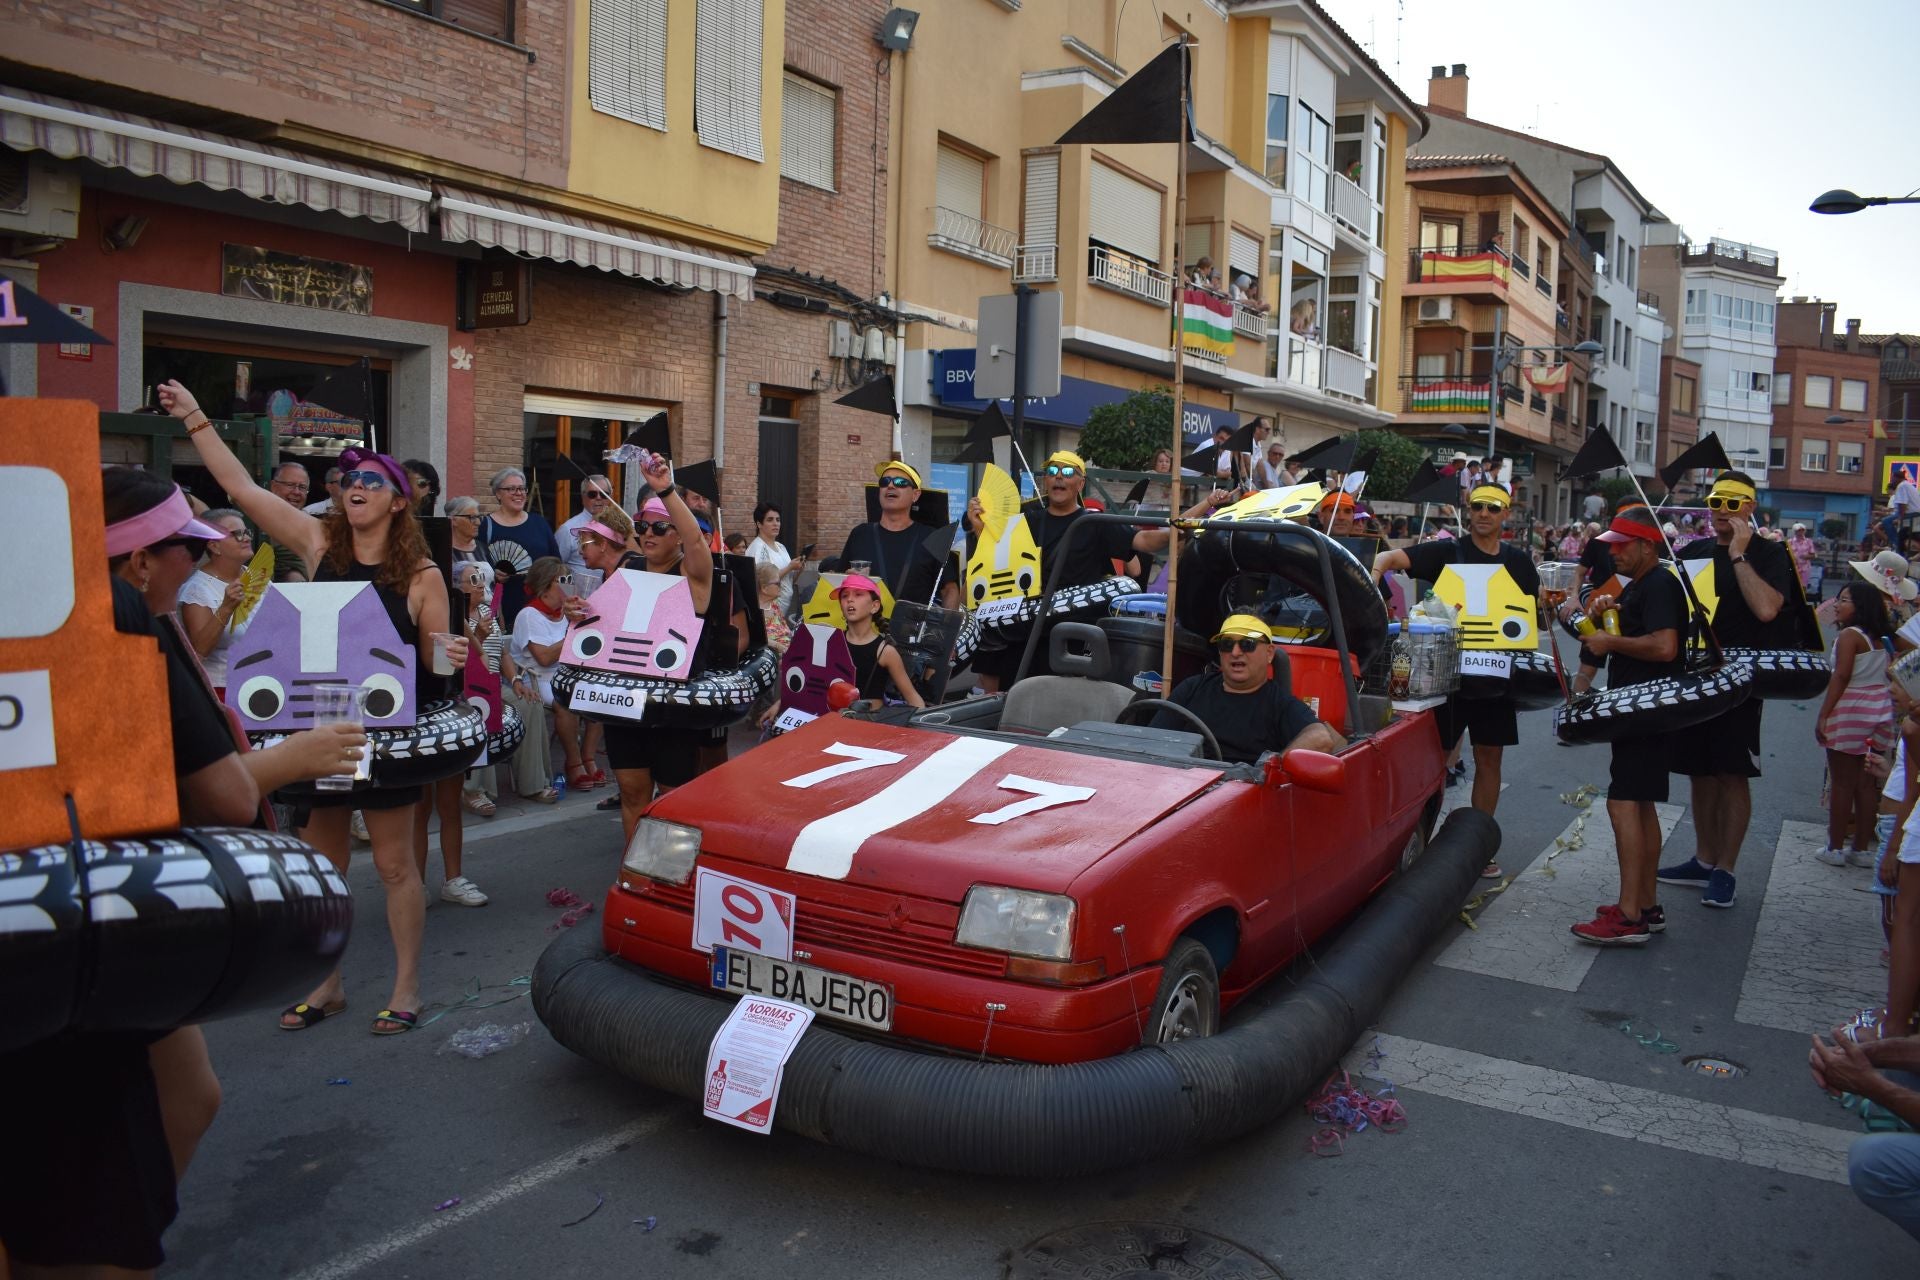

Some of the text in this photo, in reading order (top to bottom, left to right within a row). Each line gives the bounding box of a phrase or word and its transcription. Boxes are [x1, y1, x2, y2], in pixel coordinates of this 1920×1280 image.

[482, 291, 513, 304] CERVEZAS
[480, 303, 514, 316] ALHAMBRA
[946, 369, 976, 383] BBV
[1183, 410, 1213, 435] BBVA
[979, 602, 1018, 616] EL BAJERO
[1464, 656, 1506, 670] BAJERO
[575, 689, 635, 708] EL BAJERO
[782, 716, 794, 726] EL
[780, 741, 909, 789] 7
[966, 773, 1097, 825] 7
[721, 884, 764, 950] 10
[716, 971, 723, 982] E
[728, 953, 887, 1023] EL BAJERO
[745, 1003, 796, 1022] NORMAS
[710, 1079, 725, 1090] NO
